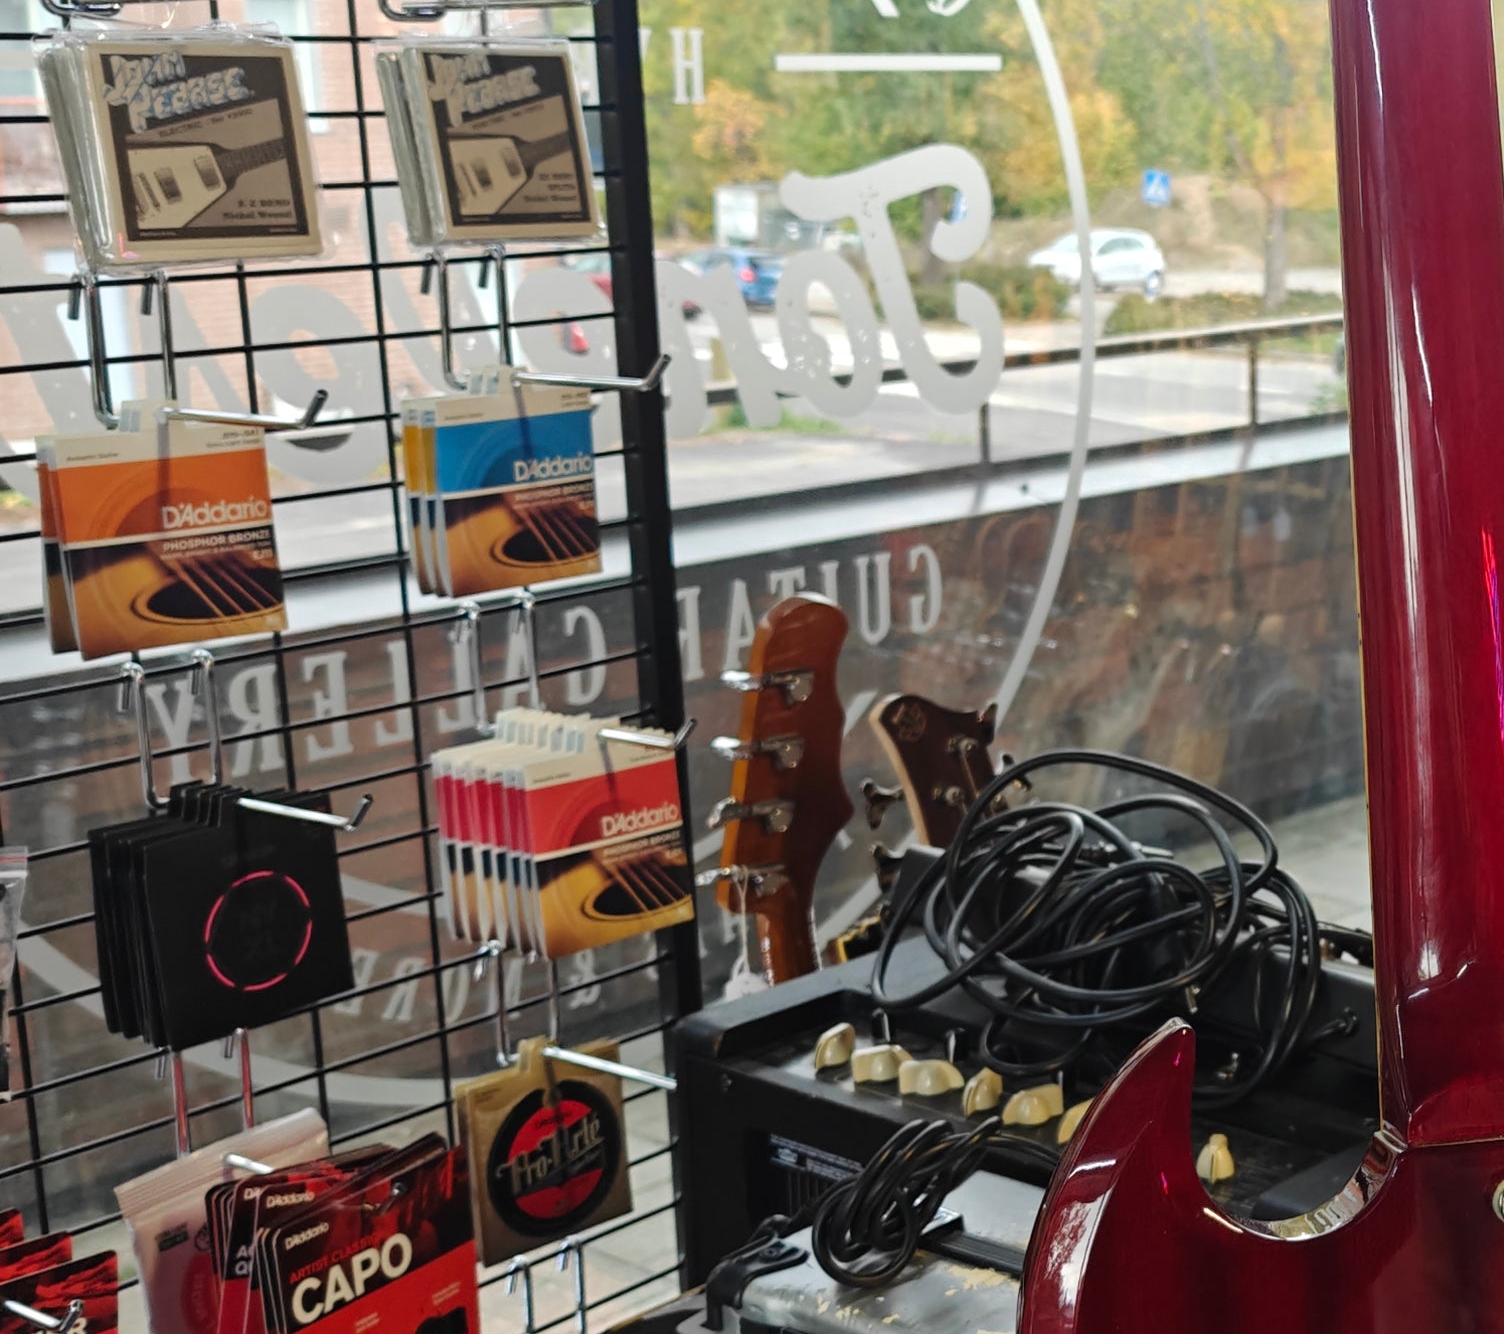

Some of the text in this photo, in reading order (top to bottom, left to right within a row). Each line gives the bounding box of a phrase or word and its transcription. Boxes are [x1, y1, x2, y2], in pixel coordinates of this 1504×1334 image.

[513, 451, 593, 483] D'Addario
[161, 495, 268, 530] D'Addario
[601, 801, 679, 837] D'Addario
[292, 1232, 413, 1325] CAPO
